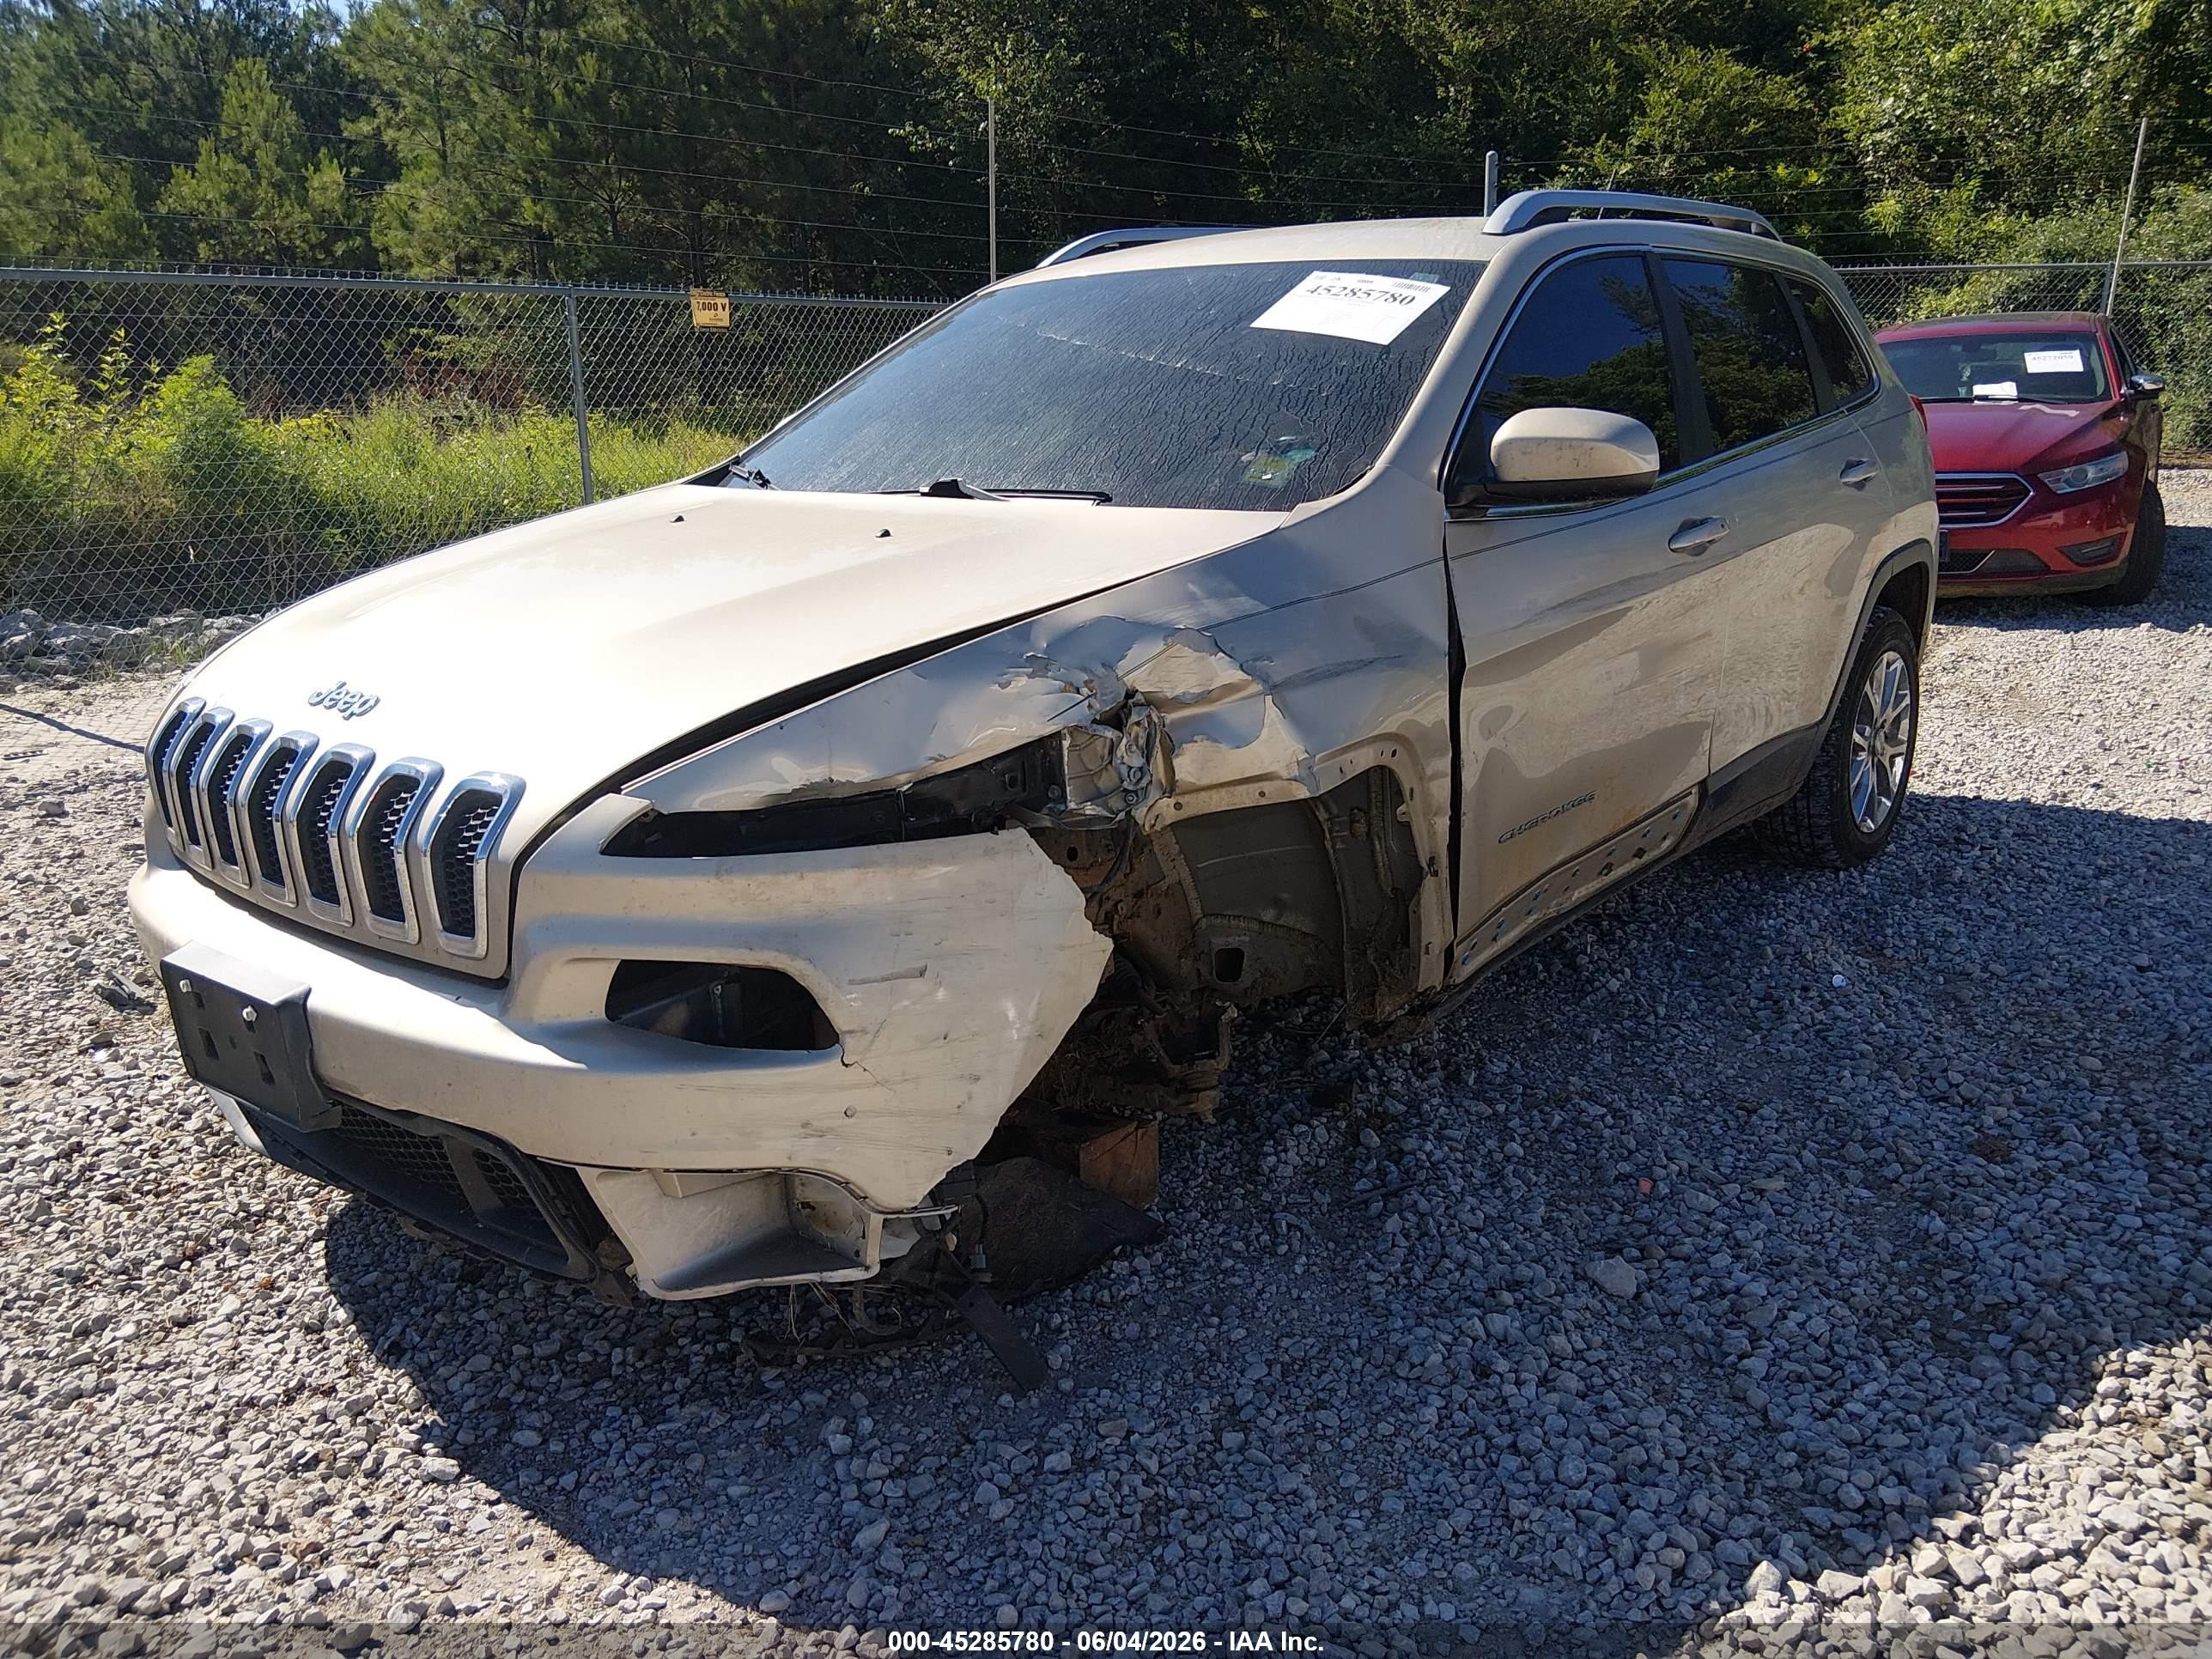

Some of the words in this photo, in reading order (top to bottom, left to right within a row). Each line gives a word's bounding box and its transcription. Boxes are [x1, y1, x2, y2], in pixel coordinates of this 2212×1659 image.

[696, 301, 719, 313] 7,000
[720, 301, 727, 312] V
[1305, 283, 1416, 307] 45285780
[307, 680, 382, 721] Jeep
[1498, 789, 1597, 844] CHEROKEE
